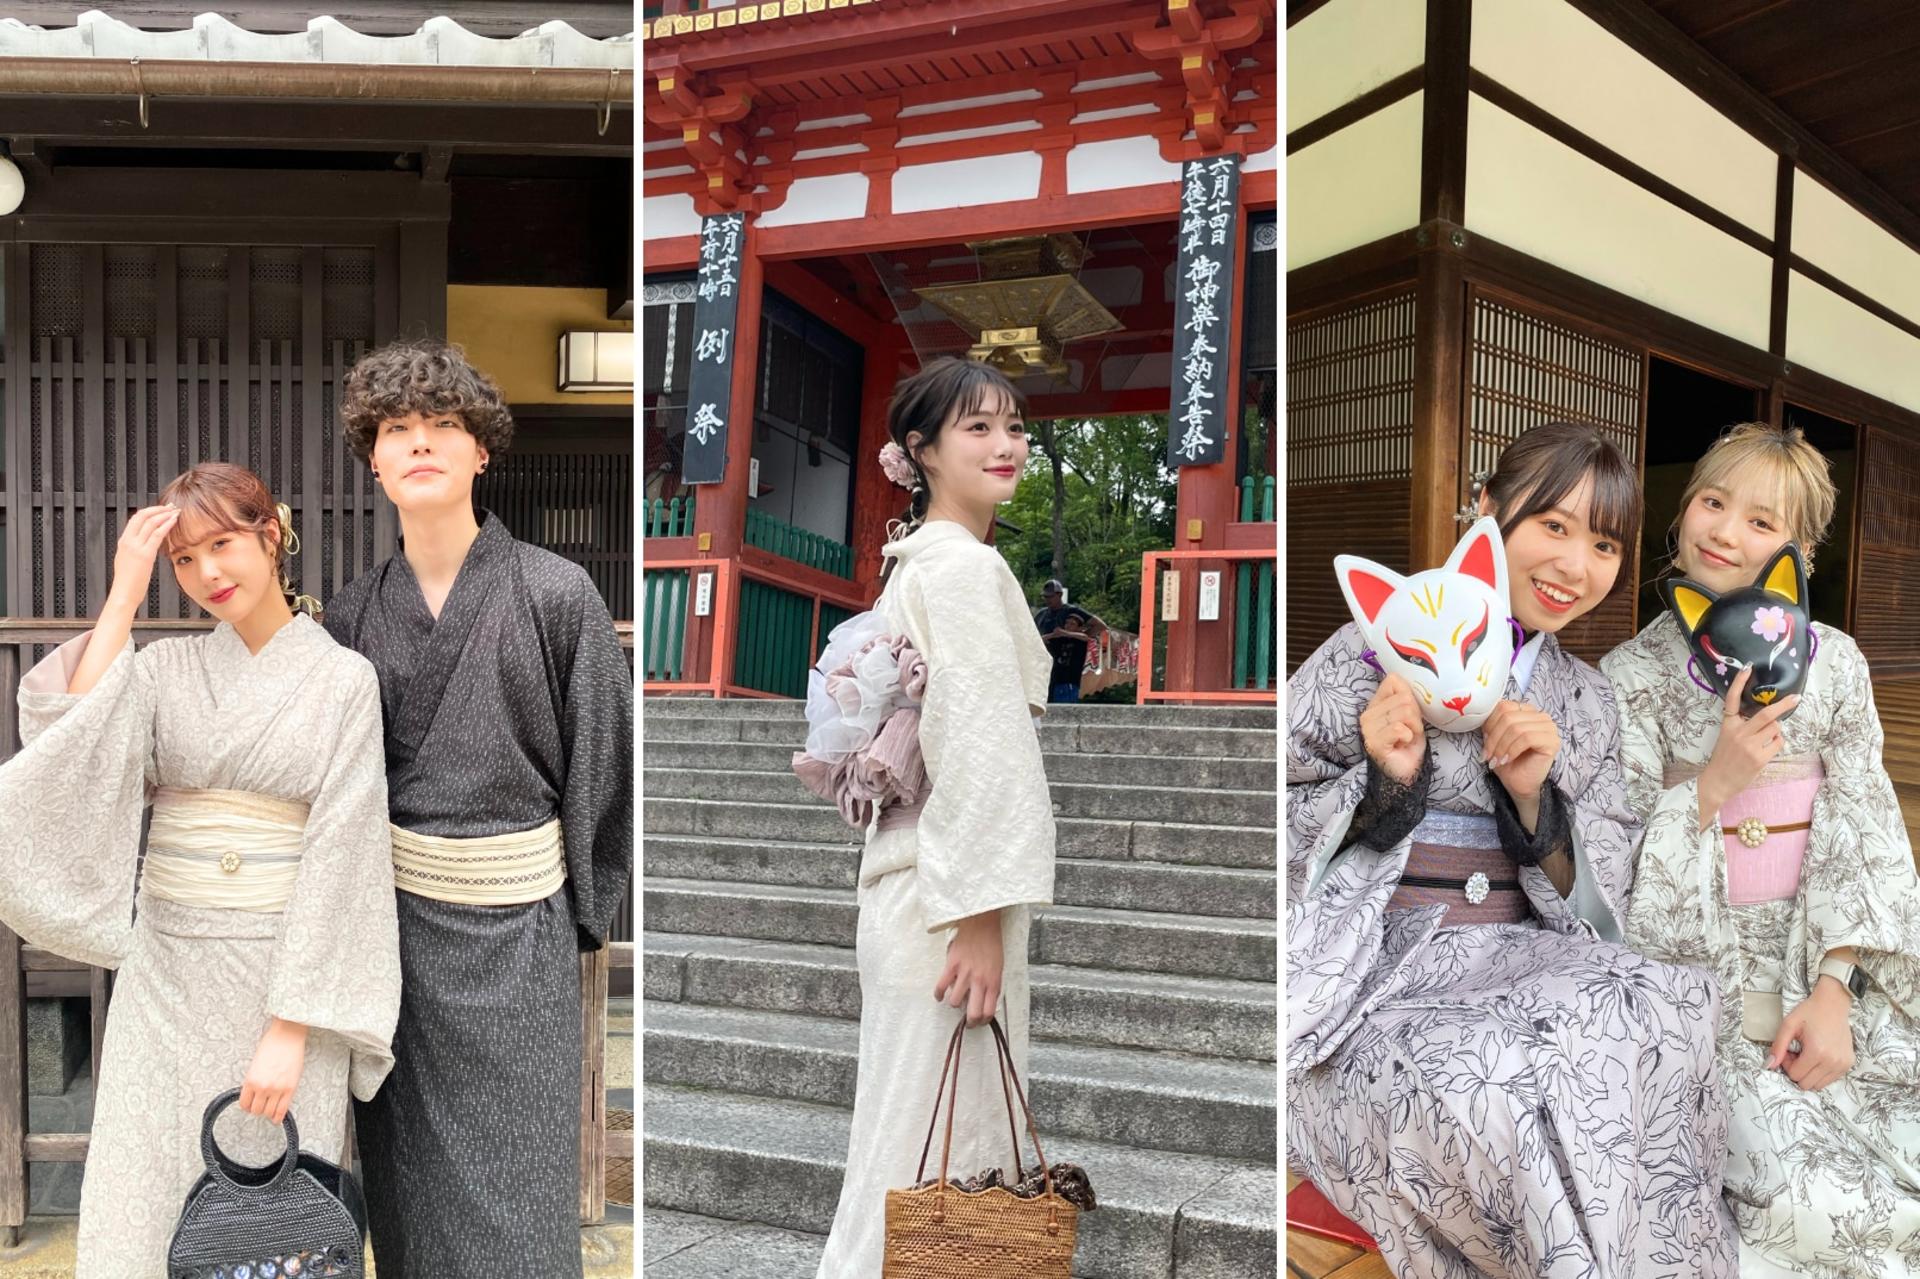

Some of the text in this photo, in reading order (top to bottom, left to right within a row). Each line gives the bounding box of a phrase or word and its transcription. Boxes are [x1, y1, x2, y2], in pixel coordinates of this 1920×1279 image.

[1181, 161, 1207, 255] 午後七時半
[1208, 157, 1233, 245] 六月十四日
[698, 218, 721, 303] 午前十時
[716, 217, 742, 297] 六月十五日
